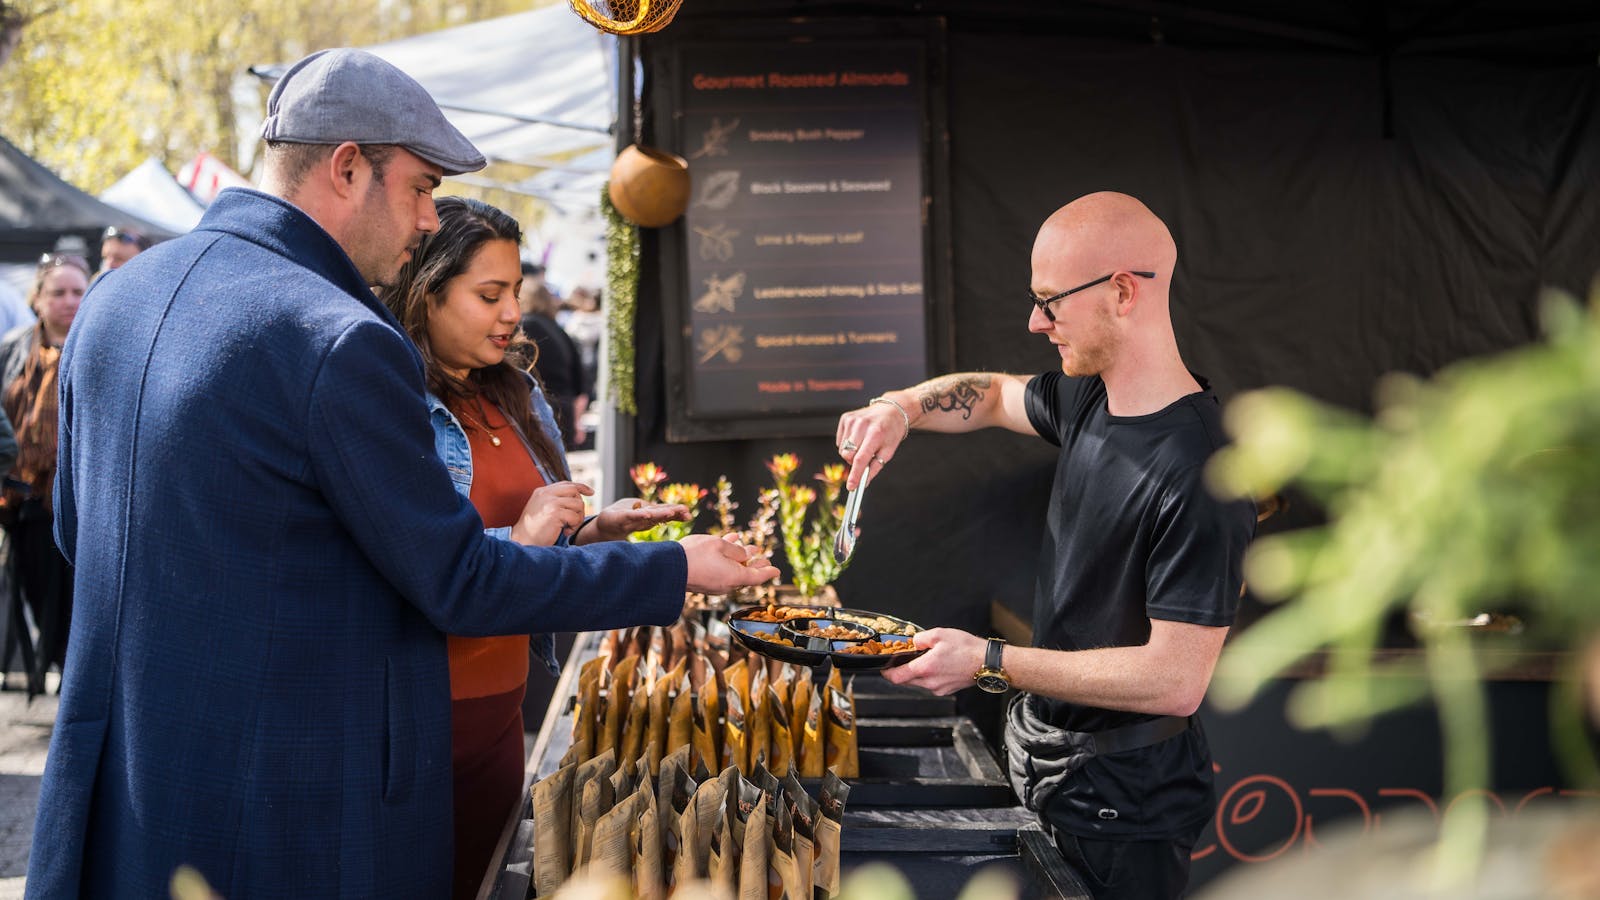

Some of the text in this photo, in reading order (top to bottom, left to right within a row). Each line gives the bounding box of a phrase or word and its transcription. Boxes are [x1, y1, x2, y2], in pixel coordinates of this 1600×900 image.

[693, 72, 909, 90] Gourmet Roasted Almonds
[826, 129, 864, 139] Pepper
[751, 180, 891, 194] Black Sesame & Seaweed
[796, 234, 834, 244] Pepper
[754, 286, 827, 299] Leatherwood
[829, 285, 865, 298] Honey
[848, 333, 897, 343] Turmeric
